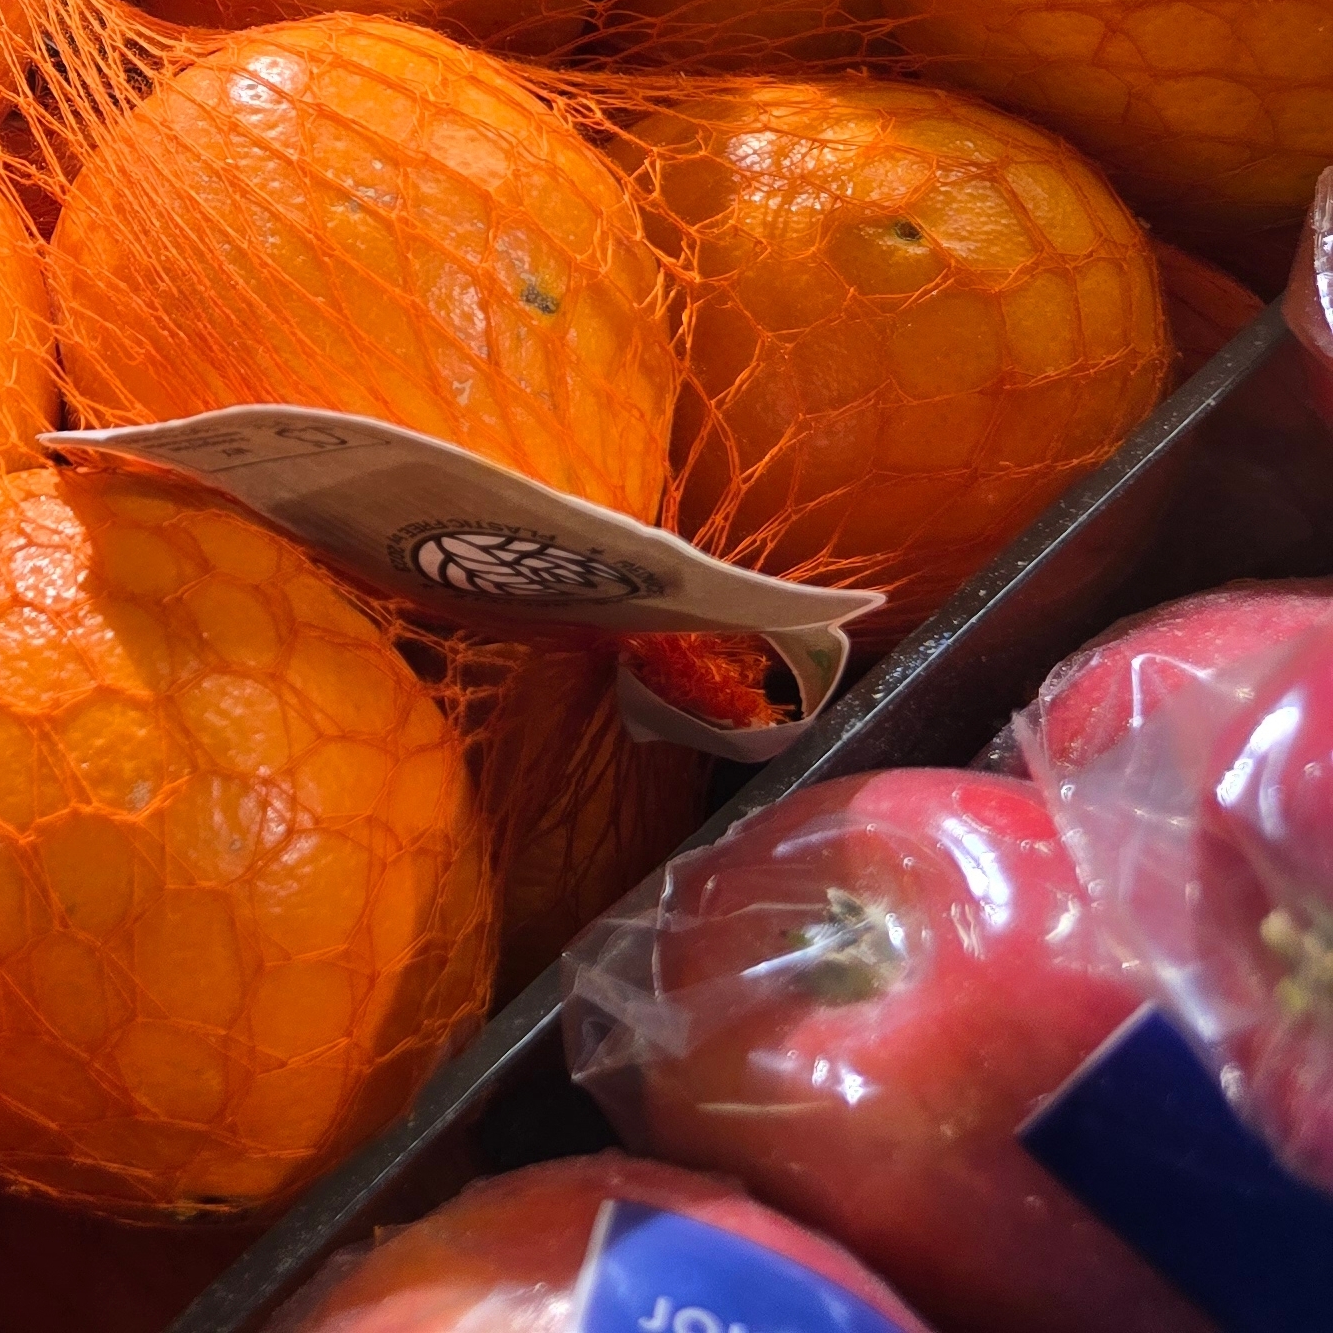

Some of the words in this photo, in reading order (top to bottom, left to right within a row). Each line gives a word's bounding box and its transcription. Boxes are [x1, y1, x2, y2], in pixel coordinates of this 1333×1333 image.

[396, 519, 448, 538] FREE
[445, 518, 556, 543] PLASTIC
[637, 1294, 748, 1333] JO
